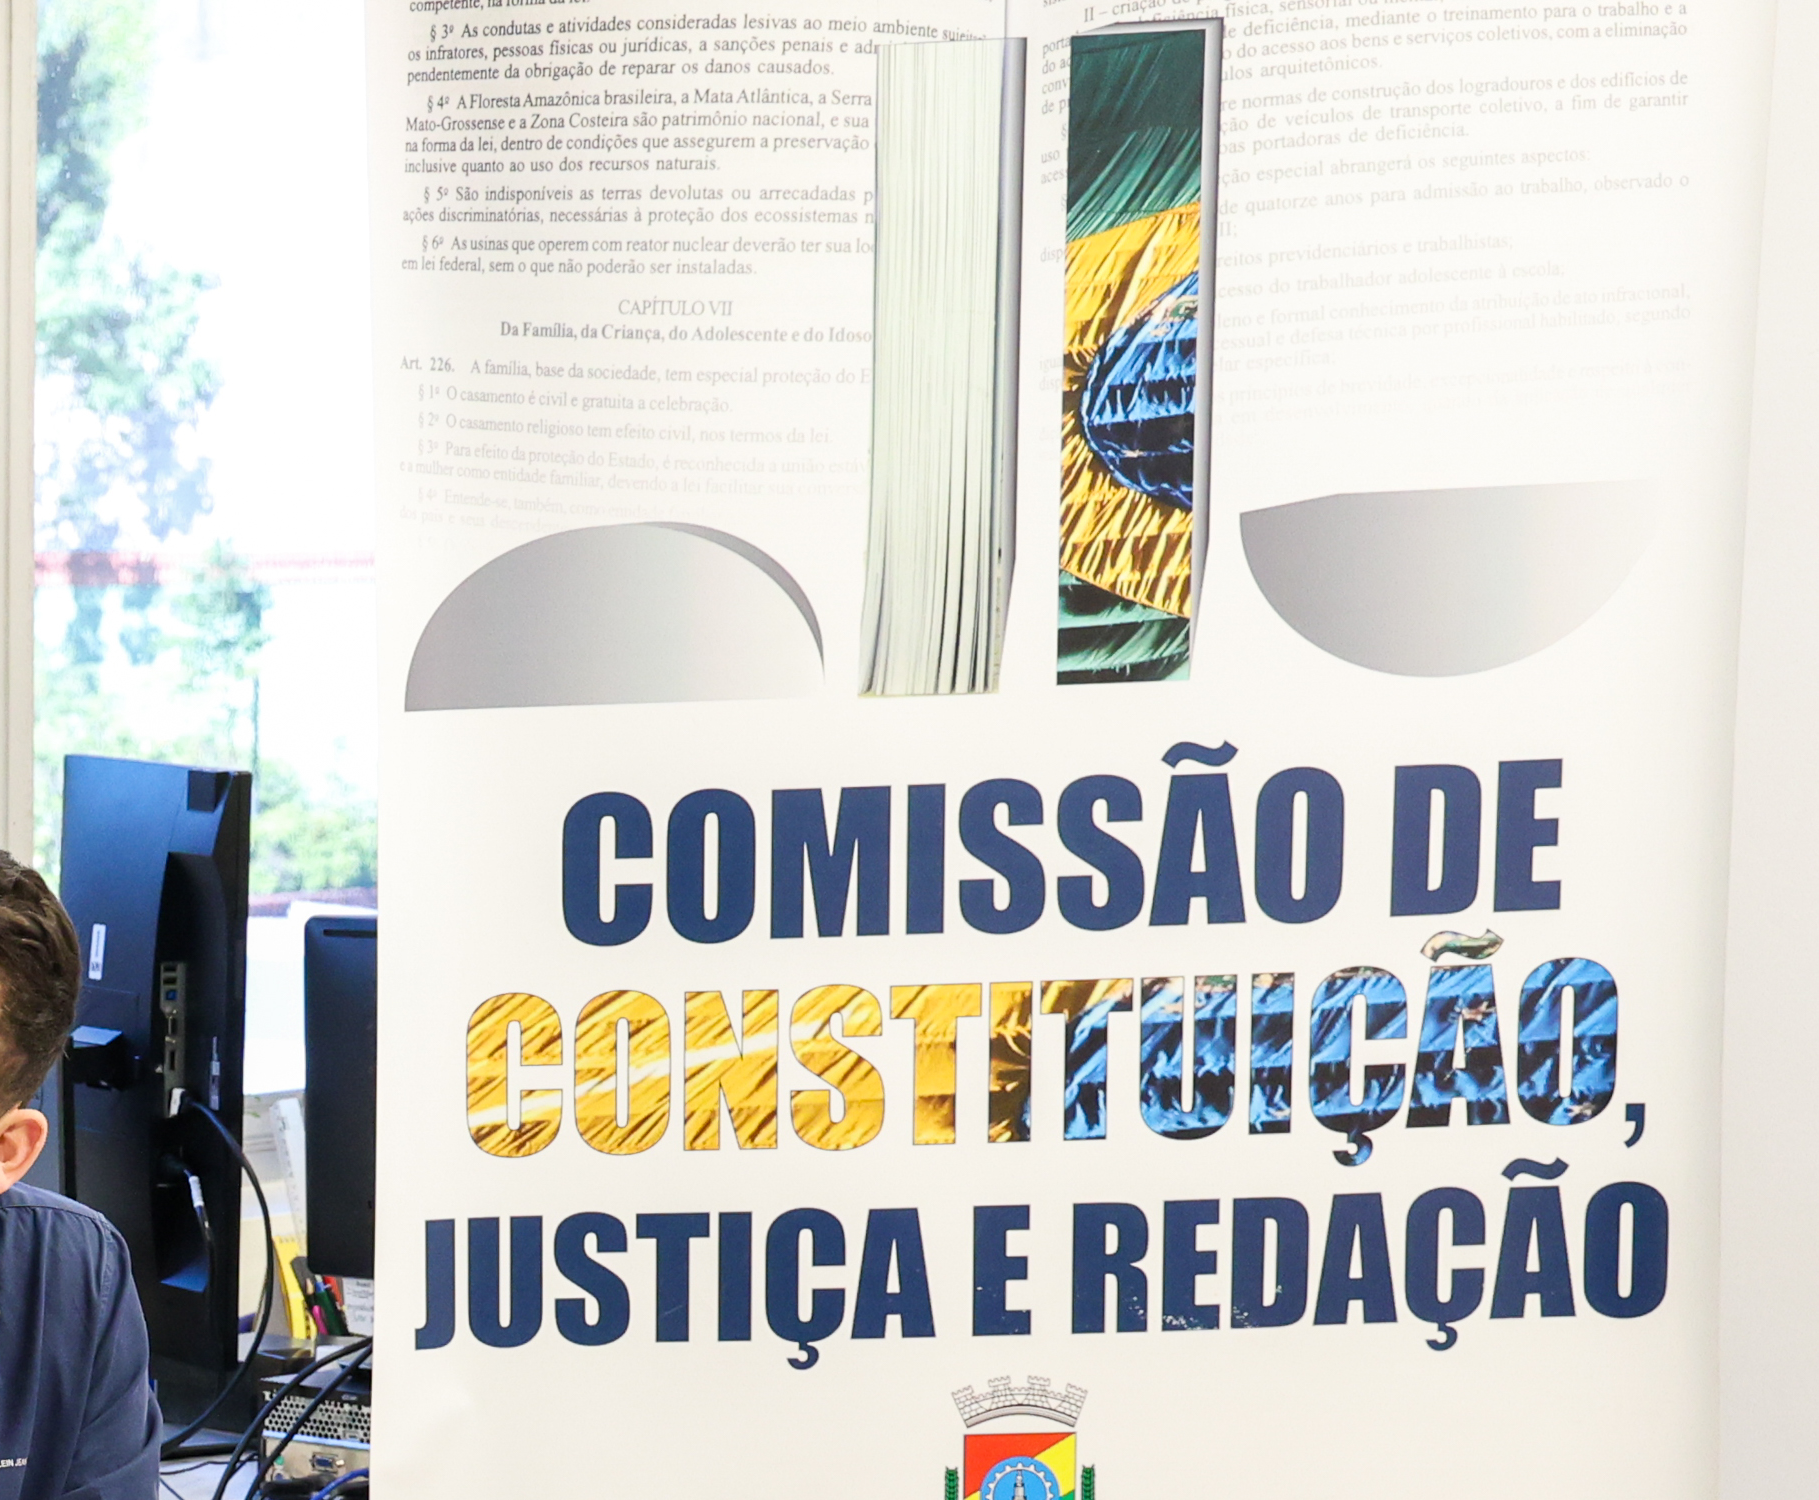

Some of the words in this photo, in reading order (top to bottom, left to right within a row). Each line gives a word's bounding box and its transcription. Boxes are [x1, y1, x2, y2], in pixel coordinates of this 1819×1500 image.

[460, 23, 478, 38] As
[482, 20, 542, 37] condutas
[546, 22, 554, 34] e
[558, 15, 631, 34] atividades
[636, 13, 737, 31] consideradas
[743, 13, 797, 30] lesivas
[803, 18, 823, 30] ao
[828, 16, 867, 32] meio
[873, 19, 938, 39] ambiente
[1243, 16, 1339, 36] deficiência,
[1345, 10, 1421, 28] mediante
[1426, 11, 1437, 23] o
[1443, 5, 1538, 22] treinamento
[1543, 6, 1577, 22] para
[1582, 6, 1592, 18] o
[1597, 0, 1659, 17] trabalho
[1664, 4, 1673, 16] e
[1678, 4, 1687, 15] a
[407, 50, 421, 62] os
[425, 44, 488, 61] infratores,
[492, 44, 544, 62] pessoas
[599, 42, 617, 54] ou
[620, 36, 692, 57] jurídicas,
[699, 40, 707, 52] a
[713, 36, 775, 55] sanções
[781, 40, 833, 56] penais
[839, 42, 848, 53] e
[1236, 43, 1257, 59] do
[1261, 41, 1316, 56] acesso
[1319, 38, 1347, 51] aos
[1351, 33, 1389, 49] bens
[1393, 34, 1402, 46] e
[1406, 28, 1473, 47] serviços
[1476, 24, 1553, 42] coletivos,
[1556, 27, 1590, 39] com
[1593, 27, 1602, 38] a
[1604, 21, 1688, 39] eliminação
[407, 66, 500, 86] pendentemente
[504, 63, 520, 79] da
[524, 61, 594, 81] obrigação
[599, 60, 616, 76] de
[622, 63, 676, 79] reparar
[681, 63, 699, 74] os
[704, 58, 751, 74] danos
[757, 59, 834, 75] causados.
[1260, 54, 1382, 79] arquitetônicos.
[456, 95, 467, 109] A
[469, 93, 521, 109] Floresta
[522, 91, 600, 108] Amazônica
[604, 89, 677, 106] brasileira,
[681, 93, 689, 104] a
[693, 88, 733, 104] Mata
[736, 88, 813, 106] Atlântica,
[818, 93, 827, 105] a
[831, 89, 872, 106] Serra
[406, 115, 505, 132] Mato-Grossense
[508, 118, 516, 130] e
[519, 118, 527, 129] a
[530, 113, 565, 129] Zona
[568, 112, 629, 128] Costeira
[633, 111, 658, 127] são
[661, 110, 748, 131] patrimônio
[752, 111, 825, 129] nacional,
[830, 116, 839, 128] e
[843, 116, 869, 128] sua
[405, 141, 418, 152] na
[421, 137, 457, 153] forma
[459, 136, 475, 152] da
[478, 136, 497, 153] lei,
[500, 135, 543, 151] dentro
[546, 134, 563, 151] de
[566, 133, 638, 153] condições
[642, 137, 669, 153] que
[673, 137, 756, 152] assegurem
[760, 137, 769, 148] a
[773, 134, 869, 153] preservação
[404, 158, 457, 173] inclusive
[461, 160, 504, 177] quanto
[509, 161, 525, 172] ao
[530, 160, 554, 172] uso
[558, 156, 583, 172] dos
[589, 159, 649, 171] recursos
[656, 158, 720, 171] naturais.
[402, 207, 435, 224] ações
[438, 207, 544, 224] discriminatórias,
[549, 206, 628, 223] necessárias
[634, 207, 642, 222] à
[647, 207, 714, 226] proteção
[720, 206, 748, 222] dos
[754, 207, 858, 223] ecossistemas
[618, 296, 705, 316] CAPÍTULO
[708, 300, 733, 316] VII
[500, 321, 519, 337] Da
[522, 321, 578, 341] Família,
[580, 323, 598, 339] da
[601, 324, 665, 343] Criança,
[668, 325, 688, 341] do
[691, 325, 788, 342] Adolescente
[791, 330, 800, 342] e
[803, 326, 824, 342] do
[828, 326, 872, 342] Idoso
[562, 741, 1344, 946] COMISSÃO
[1390, 759, 1562, 916] DE
[466, 931, 1646, 1166] CONSTITUIÇÃO,
[415, 1208, 936, 1370] JUSTIÇA
[972, 1205, 1031, 1336] E
[1072, 1157, 1669, 1351] REDAÇÃO
